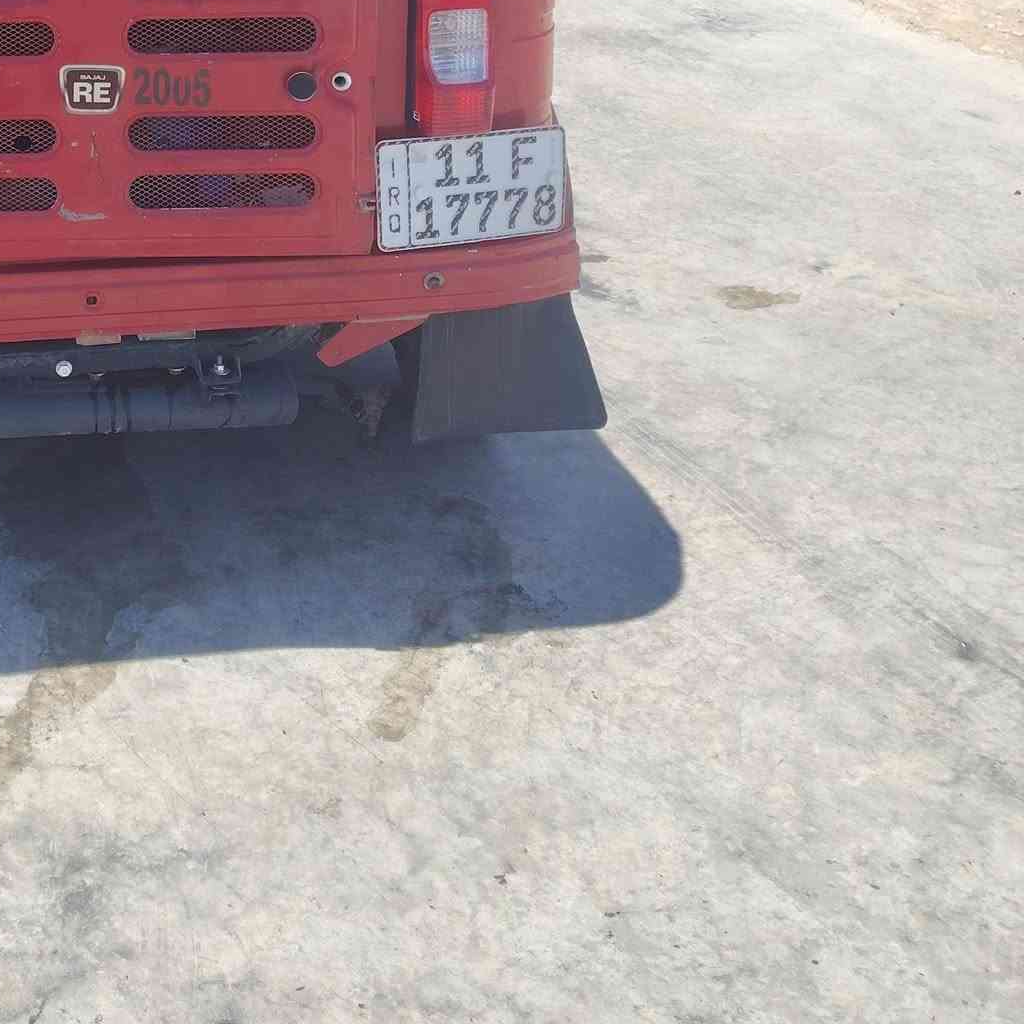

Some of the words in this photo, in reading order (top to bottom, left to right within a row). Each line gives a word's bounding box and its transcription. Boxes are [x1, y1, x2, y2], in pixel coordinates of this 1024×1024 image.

[73, 82, 112, 103] RE
[79, 74, 106, 82] BAJAJ
[435, 141, 492, 187] 11
[512, 136, 537, 179] F
[415, 184, 557, 240] 17778
